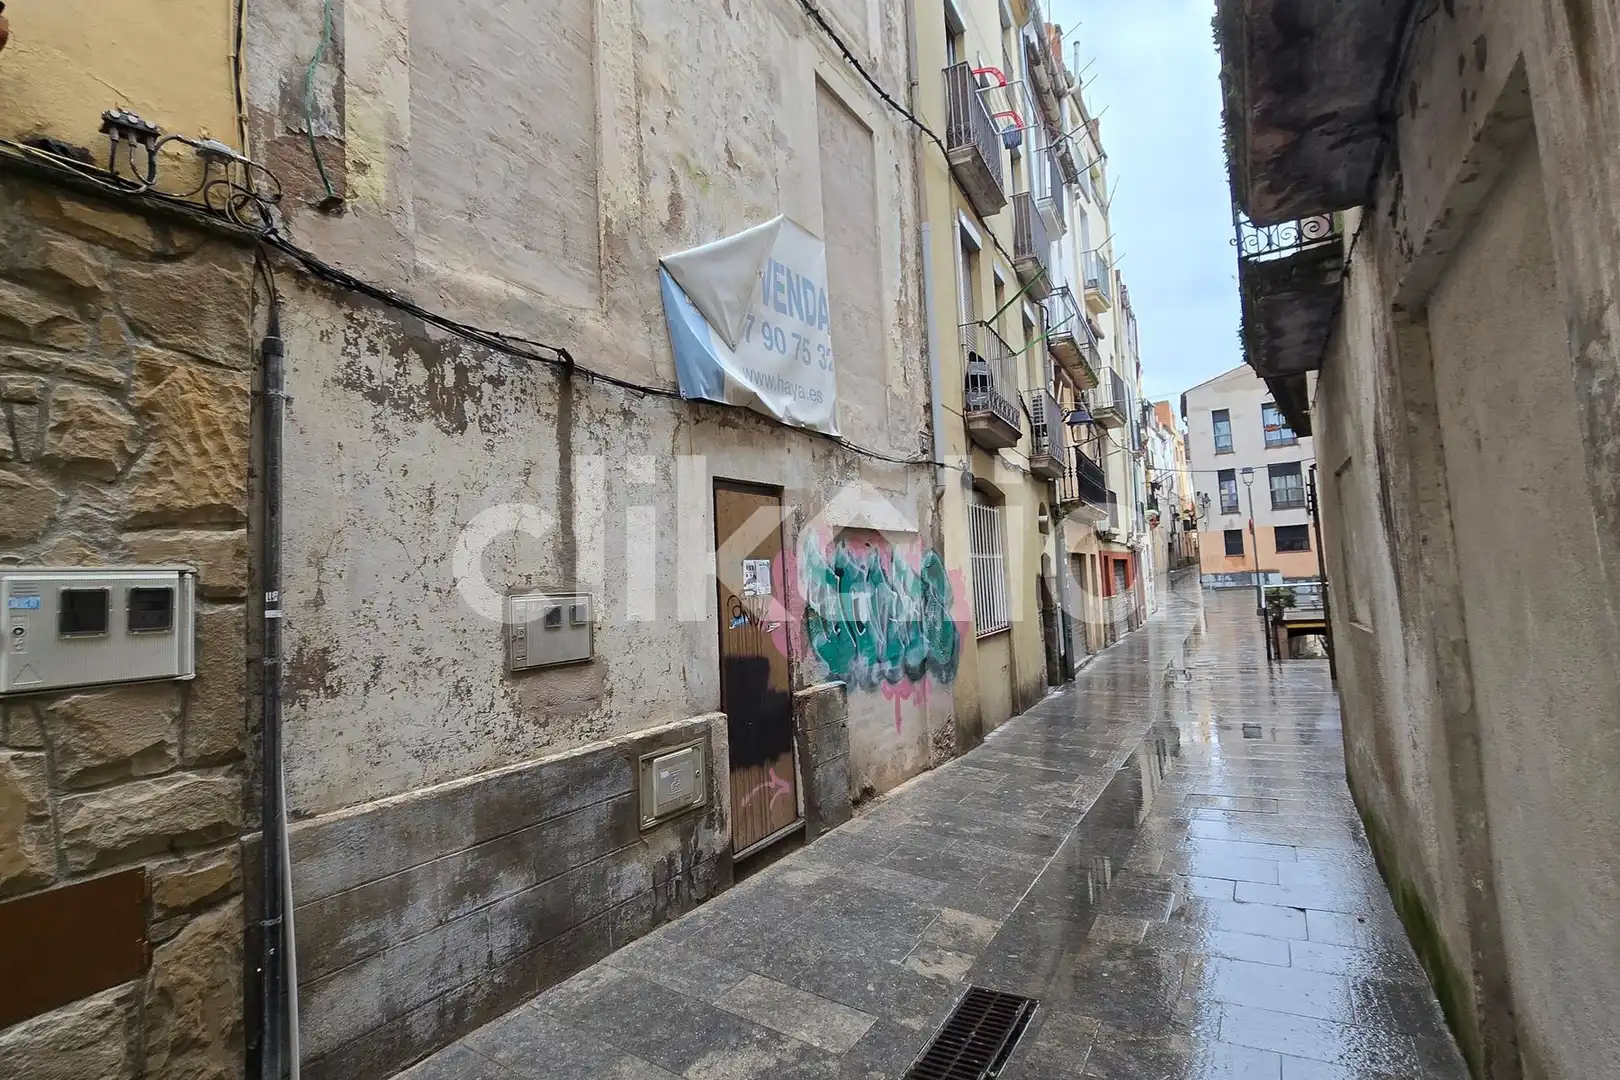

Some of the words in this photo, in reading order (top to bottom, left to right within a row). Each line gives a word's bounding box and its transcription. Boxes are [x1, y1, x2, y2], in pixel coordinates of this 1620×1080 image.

[760, 257, 830, 332] VENDA
[761, 324, 787, 356] 90
[792, 332, 812, 366] 75
[742, 366, 824, 404] www.haya.es
